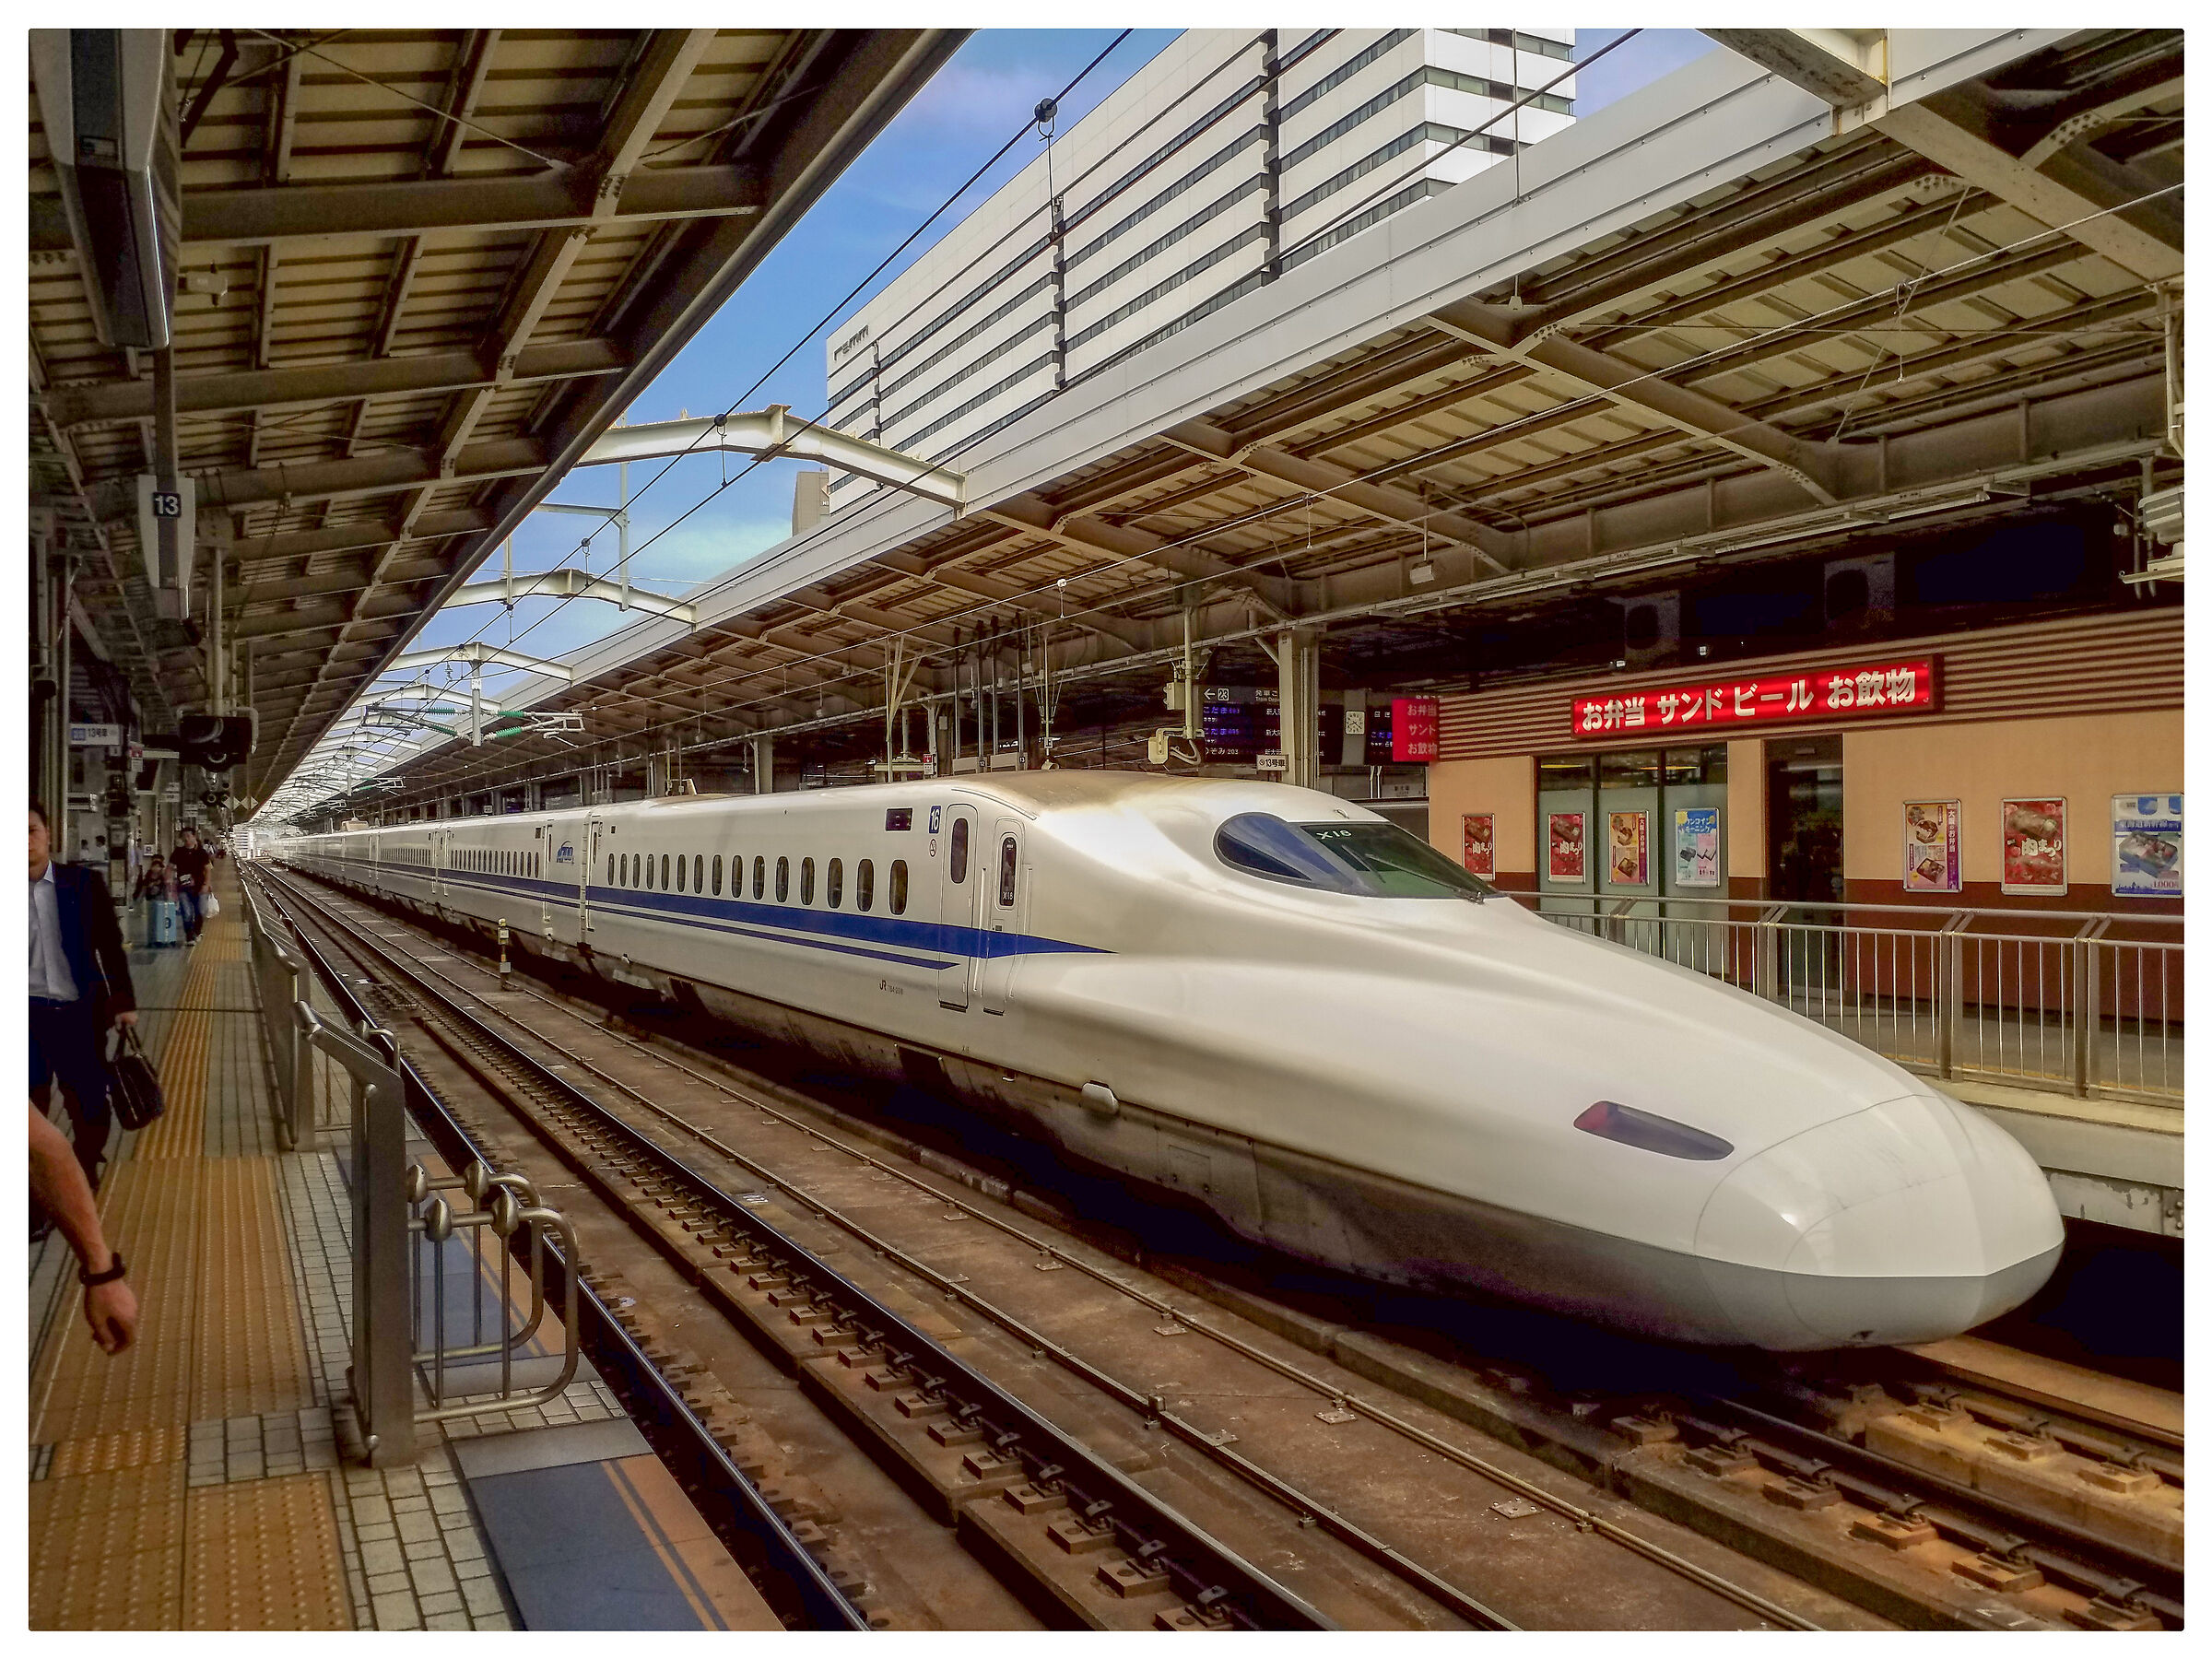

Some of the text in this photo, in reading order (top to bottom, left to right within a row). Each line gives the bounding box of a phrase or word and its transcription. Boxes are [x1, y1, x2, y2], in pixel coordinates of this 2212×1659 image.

[155, 495, 179, 515] 13
[1218, 689, 1230, 700] 23
[1582, 667, 1917, 732] お弁当 サンド ビール お飲物
[1406, 704, 1438, 717] お弁当
[1265, 759, 1286, 768] 13号車
[931, 808, 940, 831] 16
[1316, 830, 1352, 841] X18
[878, 979, 887, 991] JR
